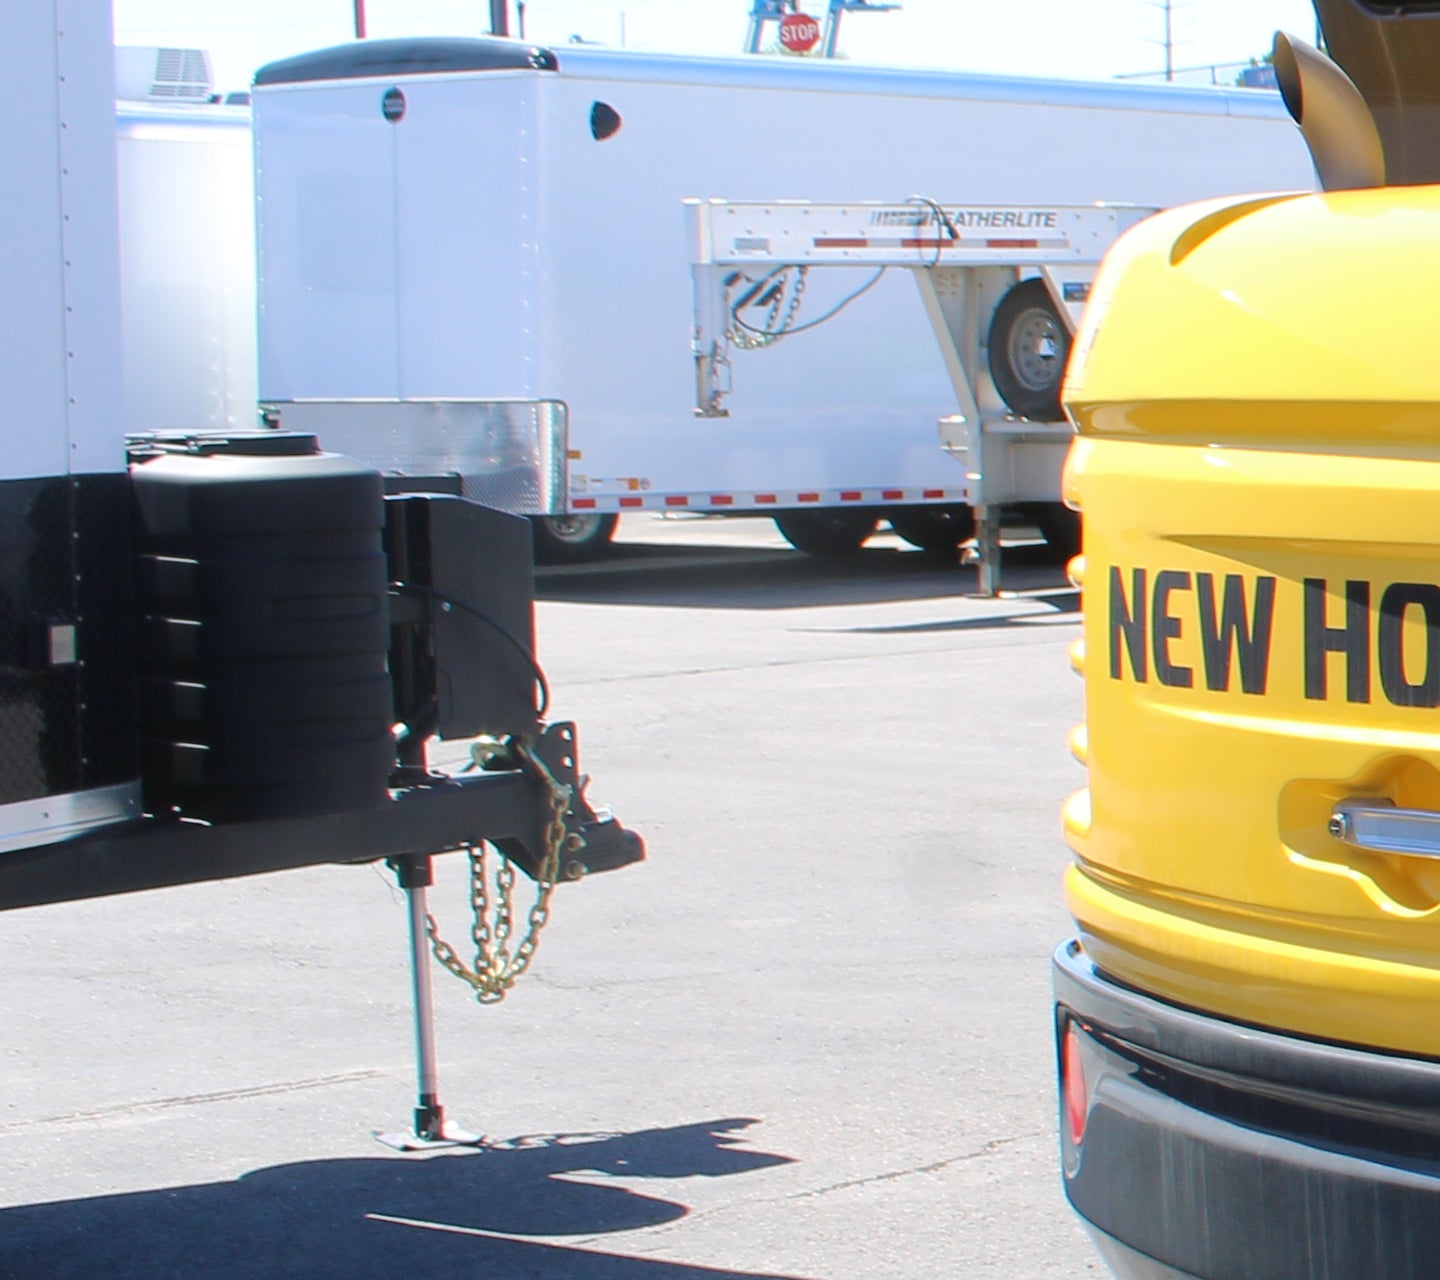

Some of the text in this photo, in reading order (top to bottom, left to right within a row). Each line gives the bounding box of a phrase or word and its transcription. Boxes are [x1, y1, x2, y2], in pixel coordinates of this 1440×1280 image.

[781, 23, 818, 42] STOP
[931, 211, 1058, 228] FEATHERLITE
[1108, 565, 1277, 696] NEW
